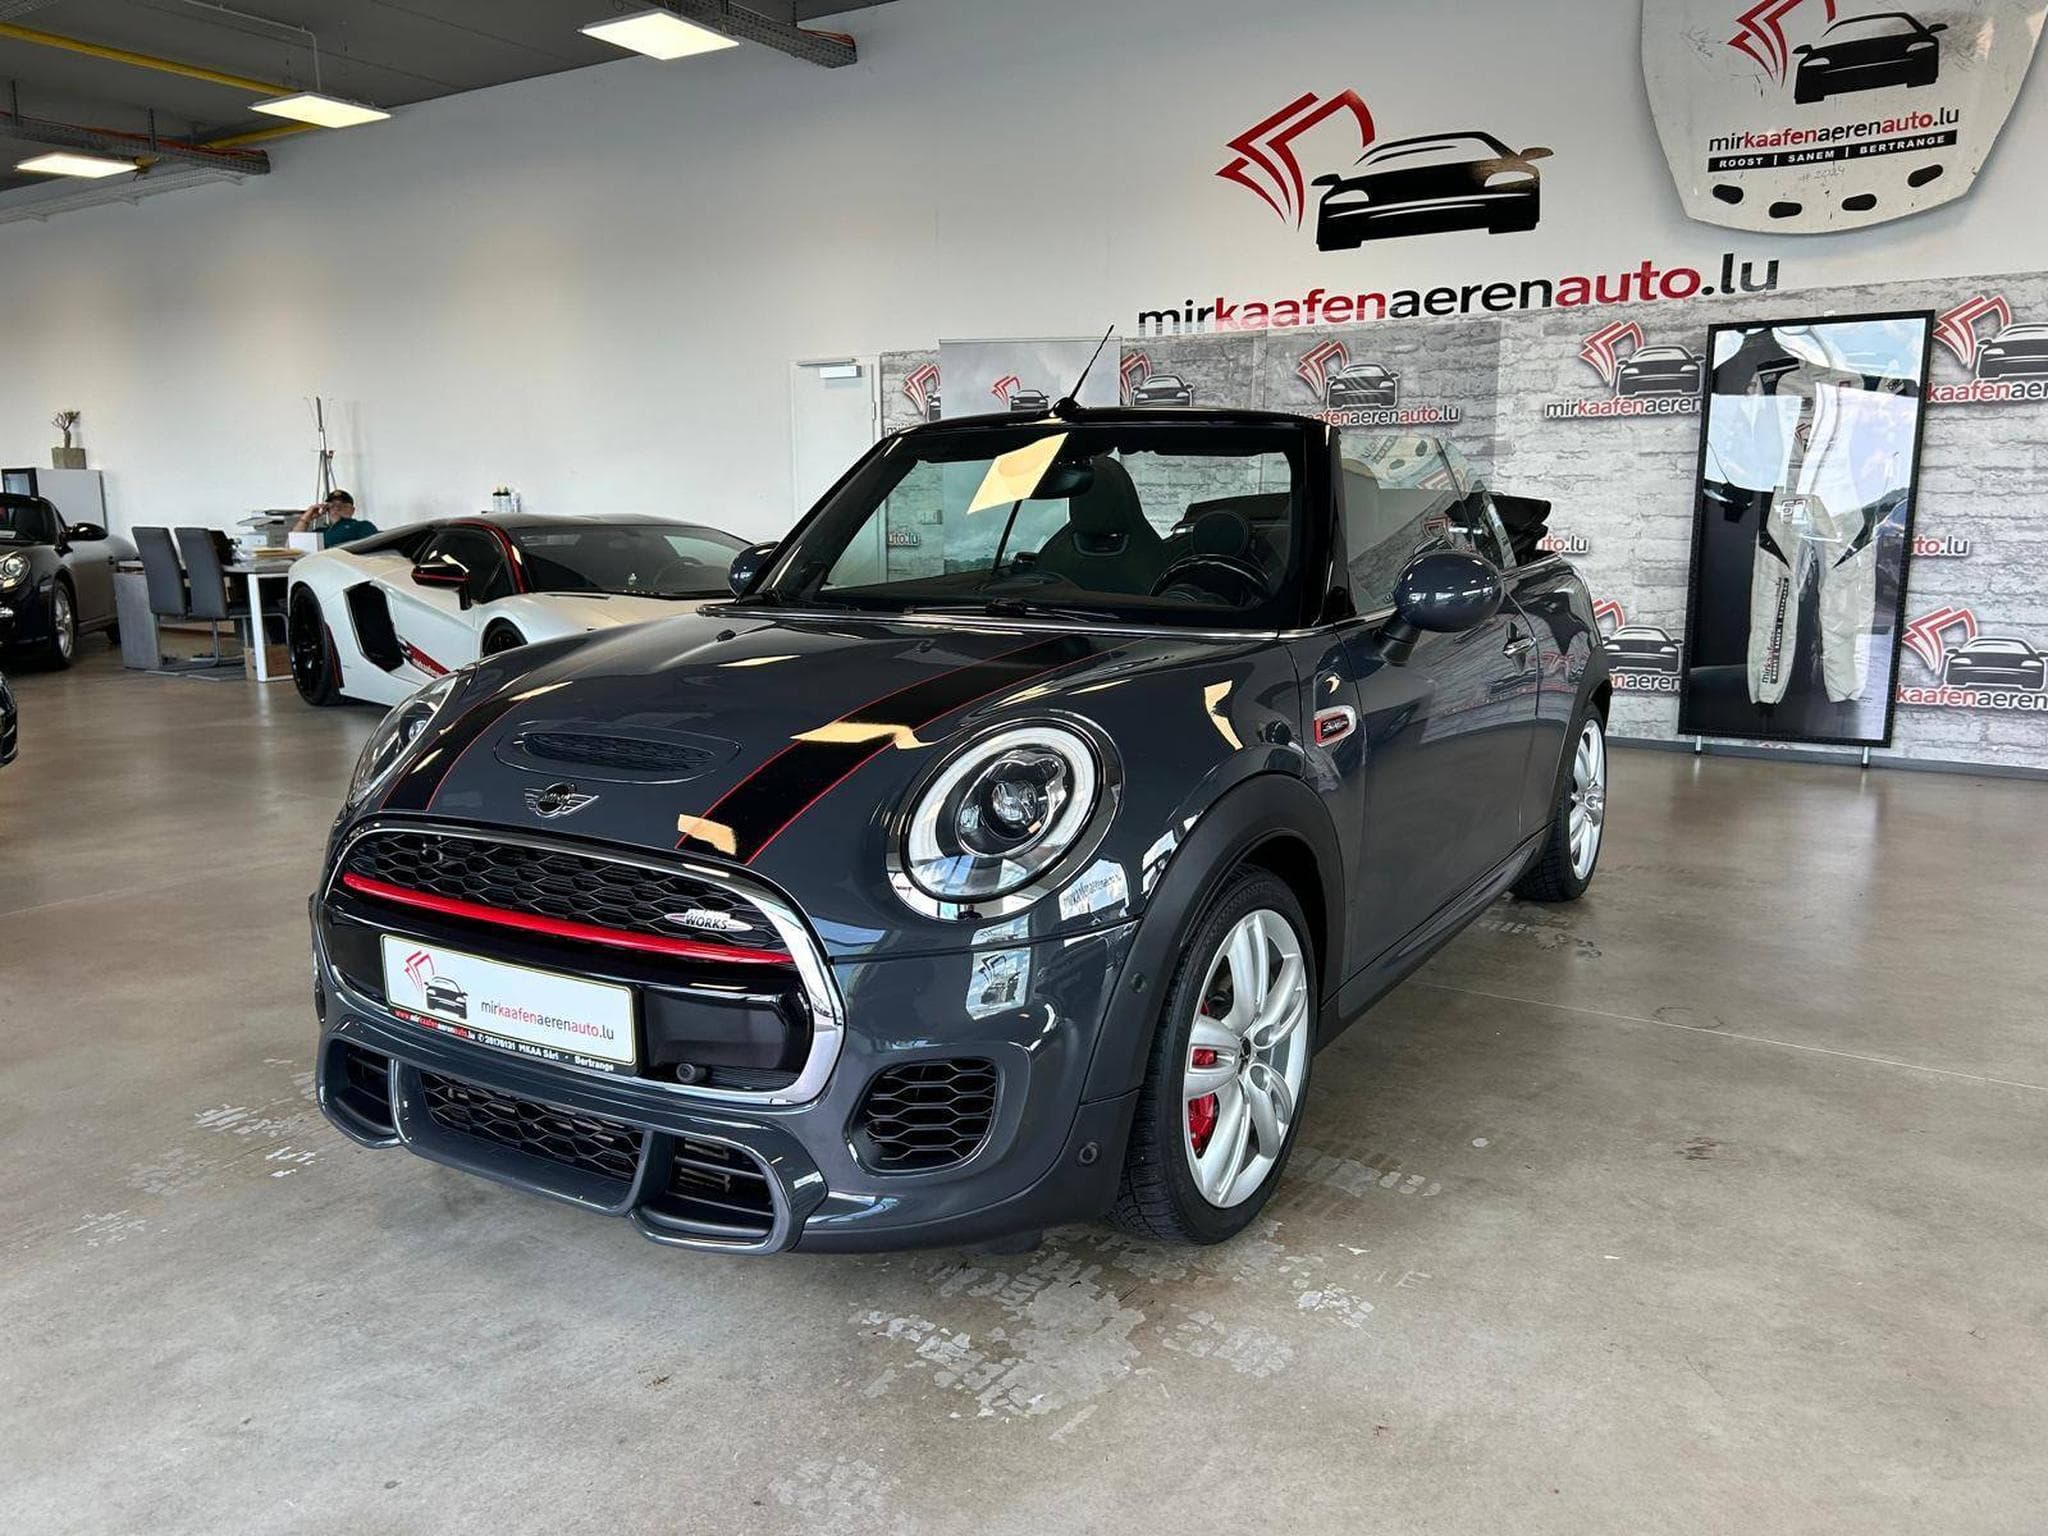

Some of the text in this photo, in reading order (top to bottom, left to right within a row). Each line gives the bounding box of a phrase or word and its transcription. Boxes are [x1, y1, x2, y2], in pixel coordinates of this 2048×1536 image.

[1708, 107, 1960, 151] mirkaafenaerenauto.lu
[1719, 134, 1945, 168] ROOST SANEM BERTRANGE
[1138, 253, 1779, 336] mirkaafenaerenauto.lu
[1914, 536, 1968, 554] to.lu
[1611, 674, 1680, 689] naeren
[686, 916, 727, 929] WORKS
[481, 999, 614, 1040] mirkaafenaerenauto.lu
